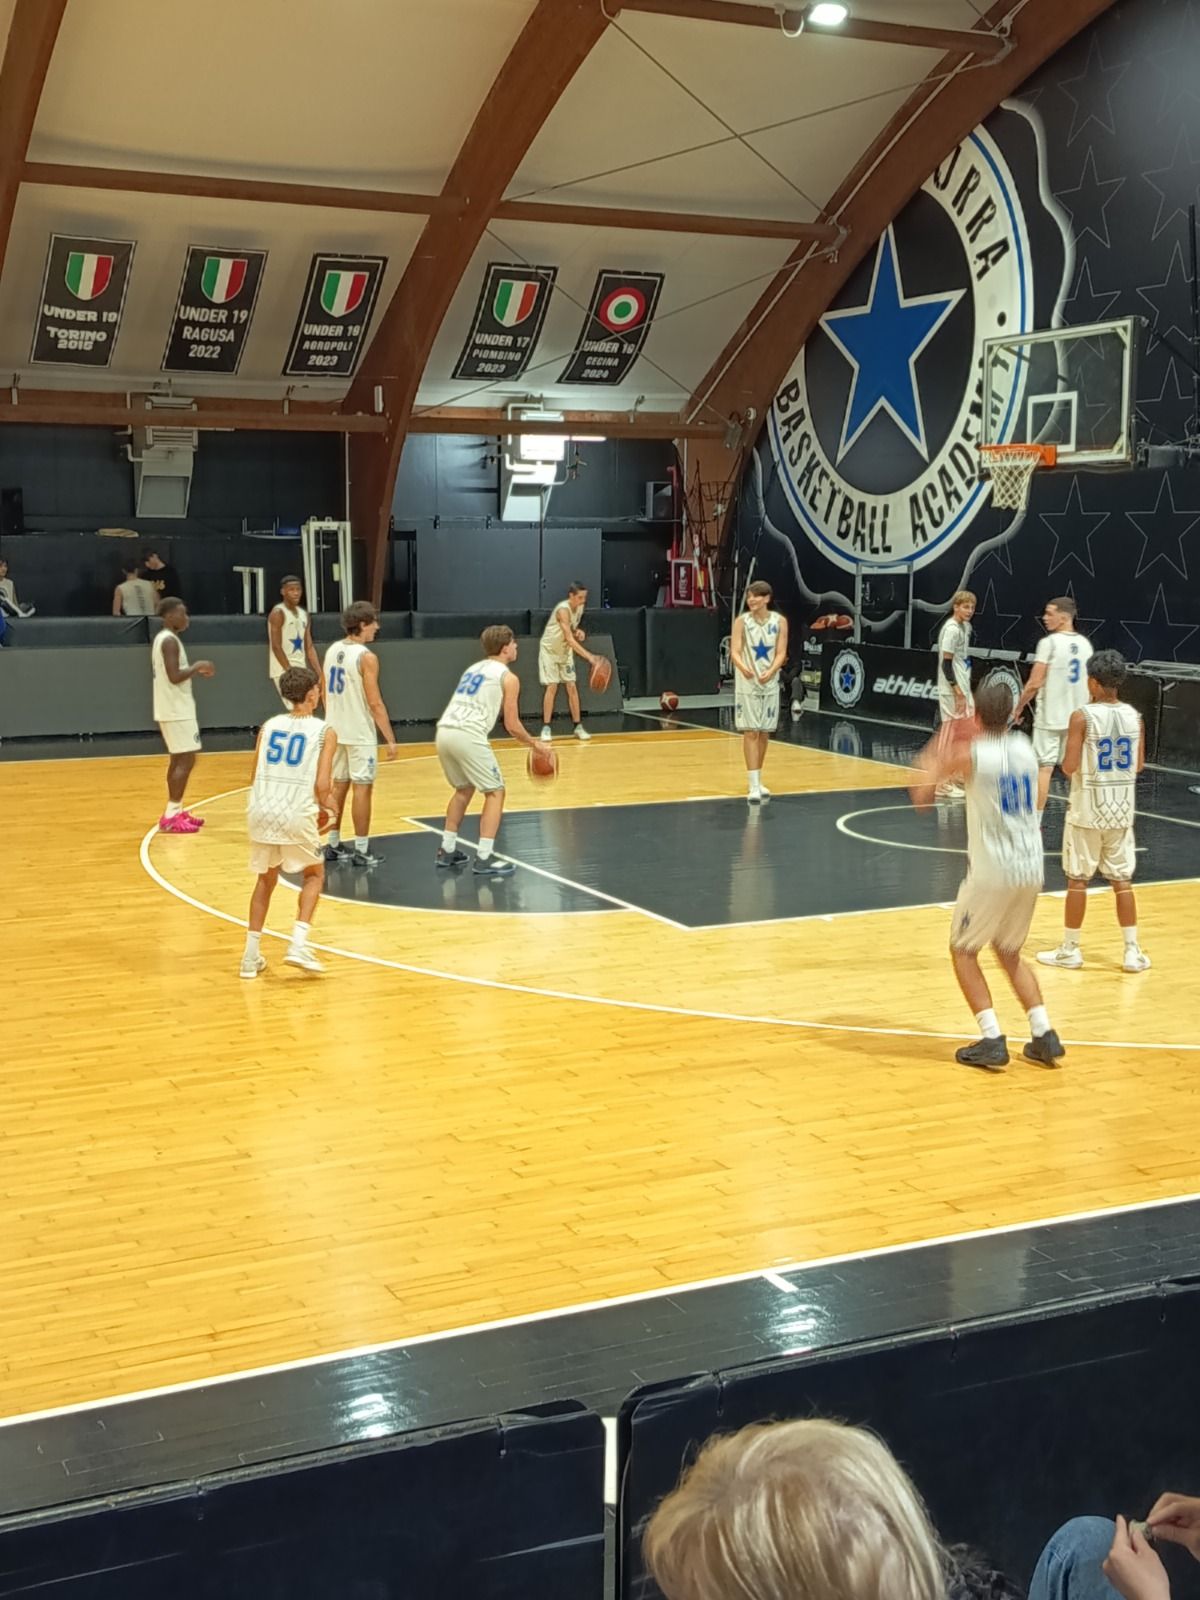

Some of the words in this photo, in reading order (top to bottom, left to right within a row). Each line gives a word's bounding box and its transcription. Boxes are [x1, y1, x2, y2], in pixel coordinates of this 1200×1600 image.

[43, 304, 98, 322] UNDER
[179, 305, 229, 324] UNDER
[232, 309, 249, 324] 19
[46, 326, 108, 342] TORINO
[182, 325, 235, 343] RAGUSA
[303, 323, 344, 337] UNDER
[302, 340, 353, 351] AGROPOLI
[475, 332, 514, 347] UNDER
[516, 335, 531, 348] 17
[582, 340, 620, 354] UNDER
[188, 344, 222, 359] 2022
[472, 348, 522, 361] PIOMBINO
[307, 354, 339, 367] 2023
[476, 362, 507, 374] 2023
[585, 356, 620, 367] CECINA
[776, 377, 893, 555] BASKETBALL
[1067, 657, 1081, 684] 3
[328, 665, 346, 695] 15
[454, 672, 486, 696] 29
[266, 731, 307, 766] 50
[1096, 736, 1133, 772] 23
